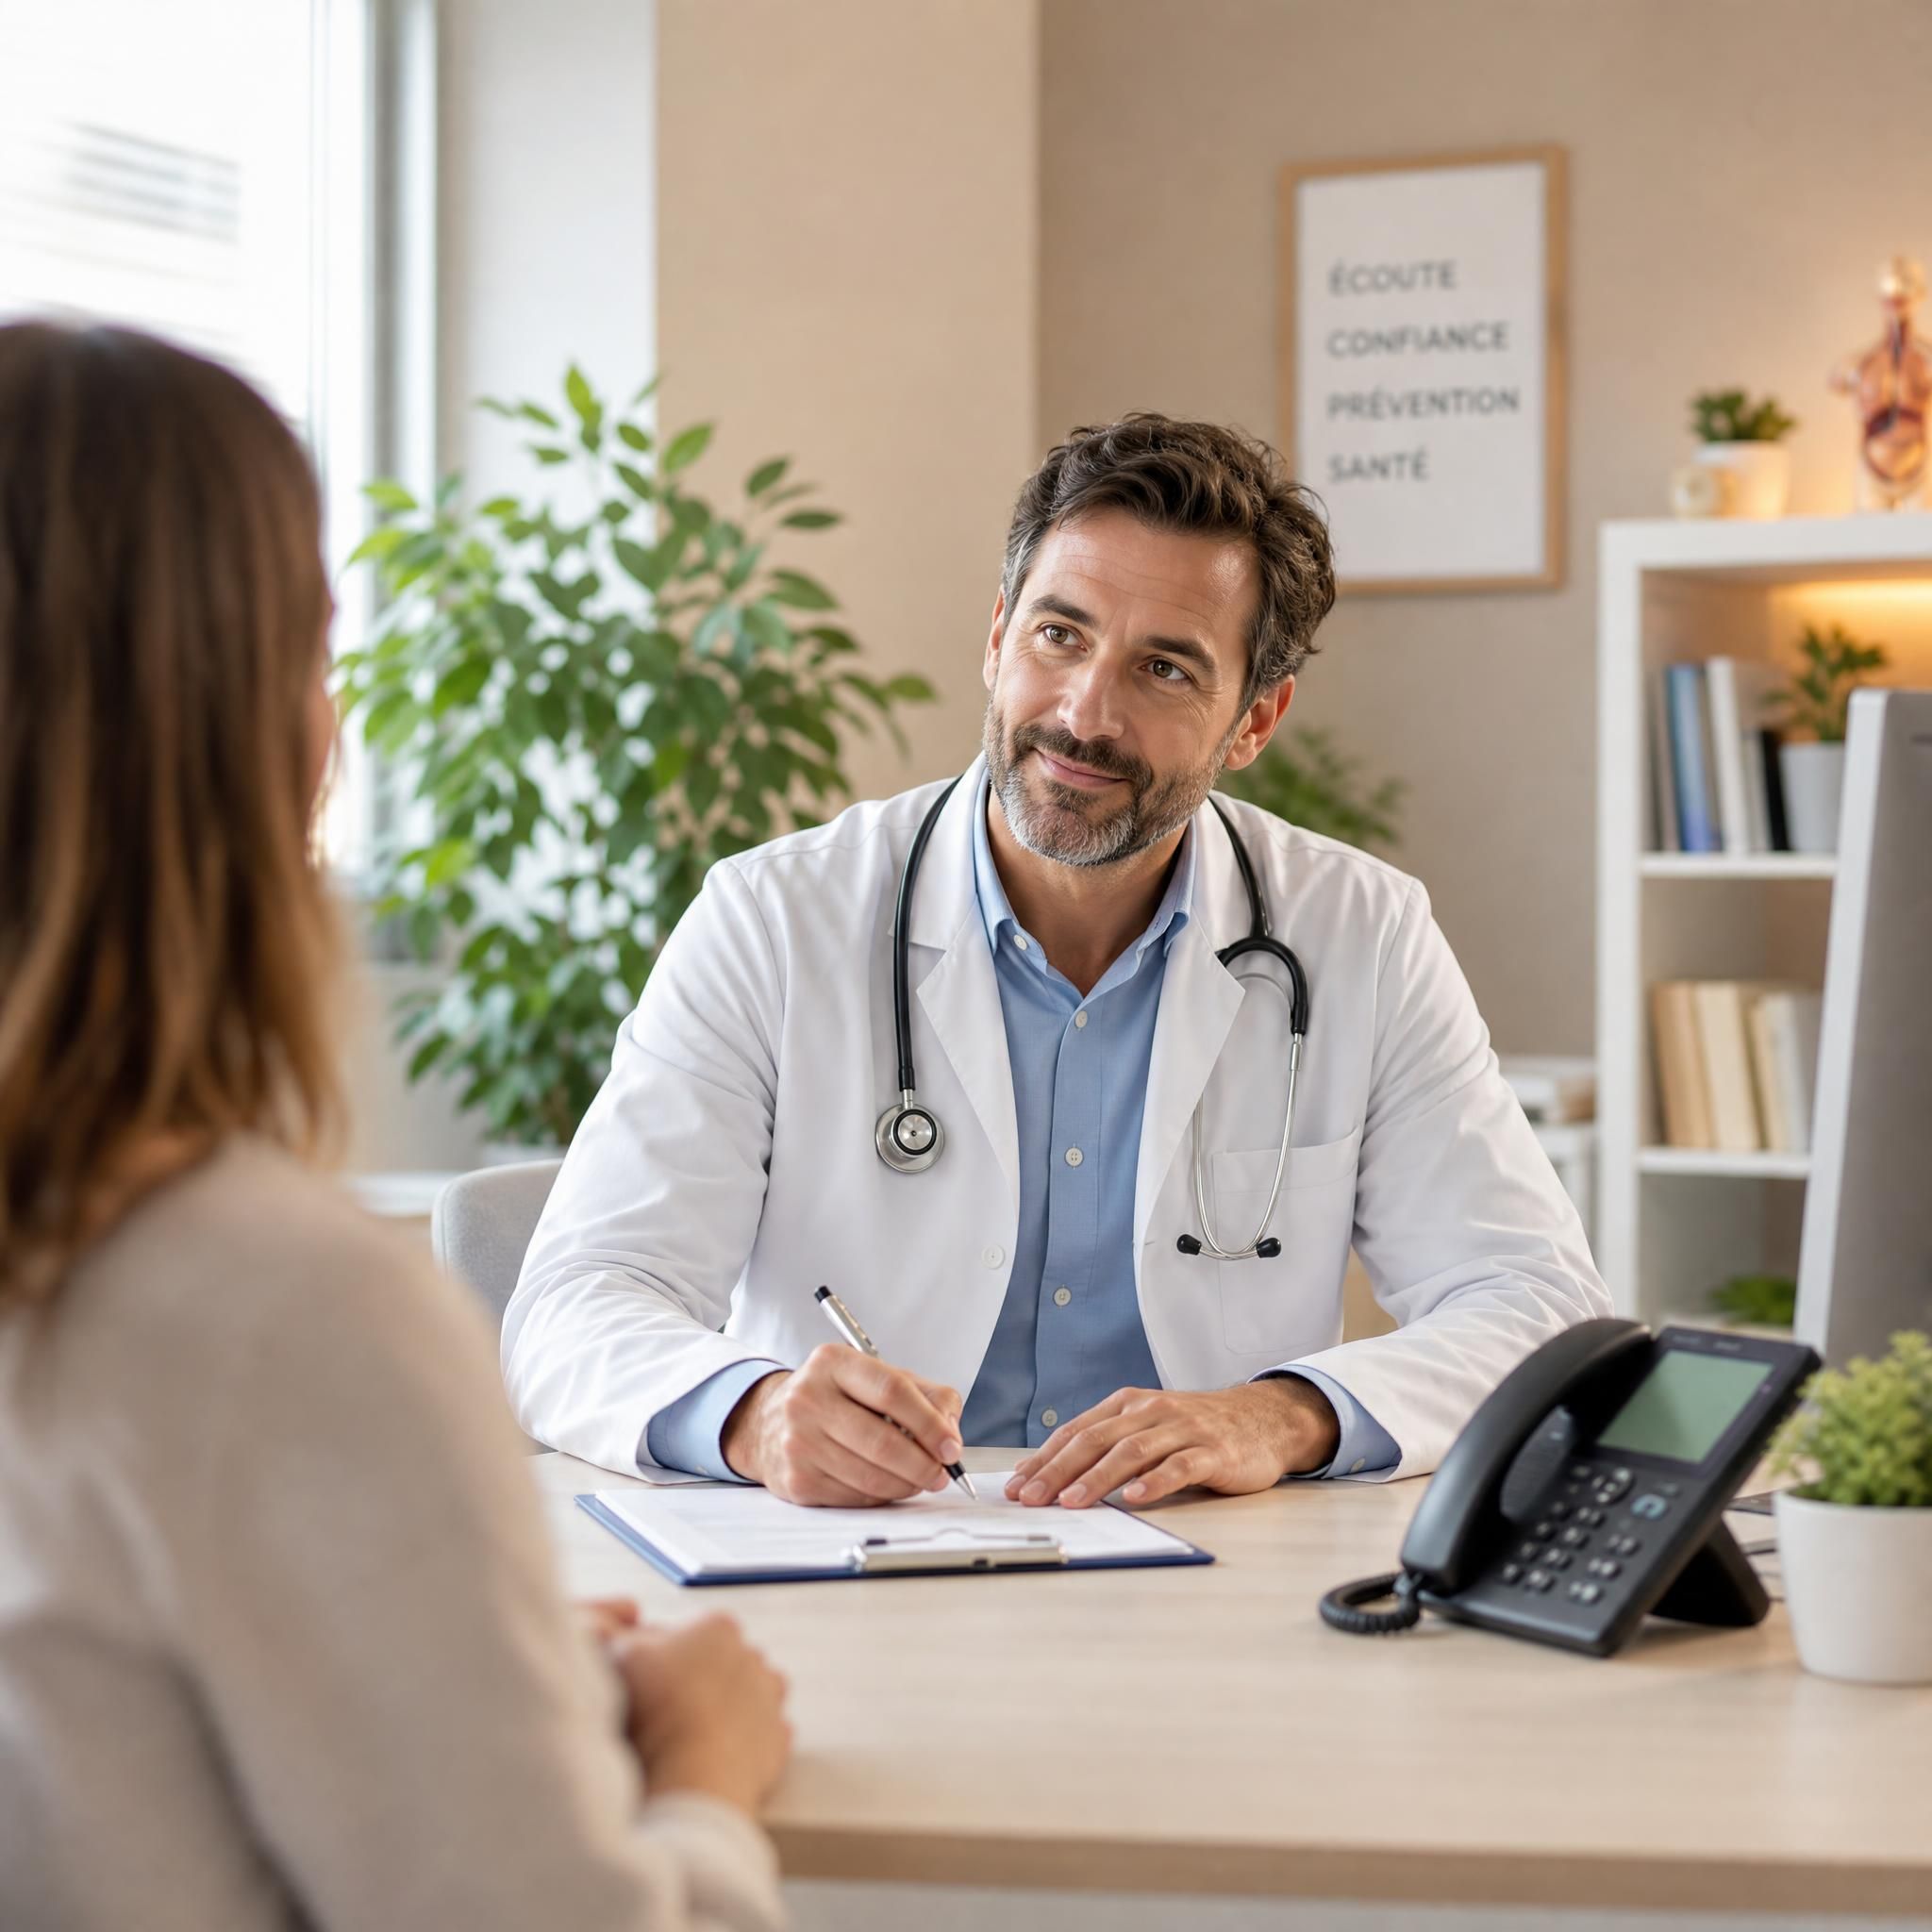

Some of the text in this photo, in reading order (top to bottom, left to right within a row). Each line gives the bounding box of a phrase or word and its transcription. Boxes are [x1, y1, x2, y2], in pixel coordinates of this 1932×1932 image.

[1329, 259, 1454, 295] ÉCOUTE
[1327, 323, 1507, 358] CONFIANCE
[1327, 386, 1519, 420] PRÉVENTION
[1328, 447, 1426, 483] SANTÉ
